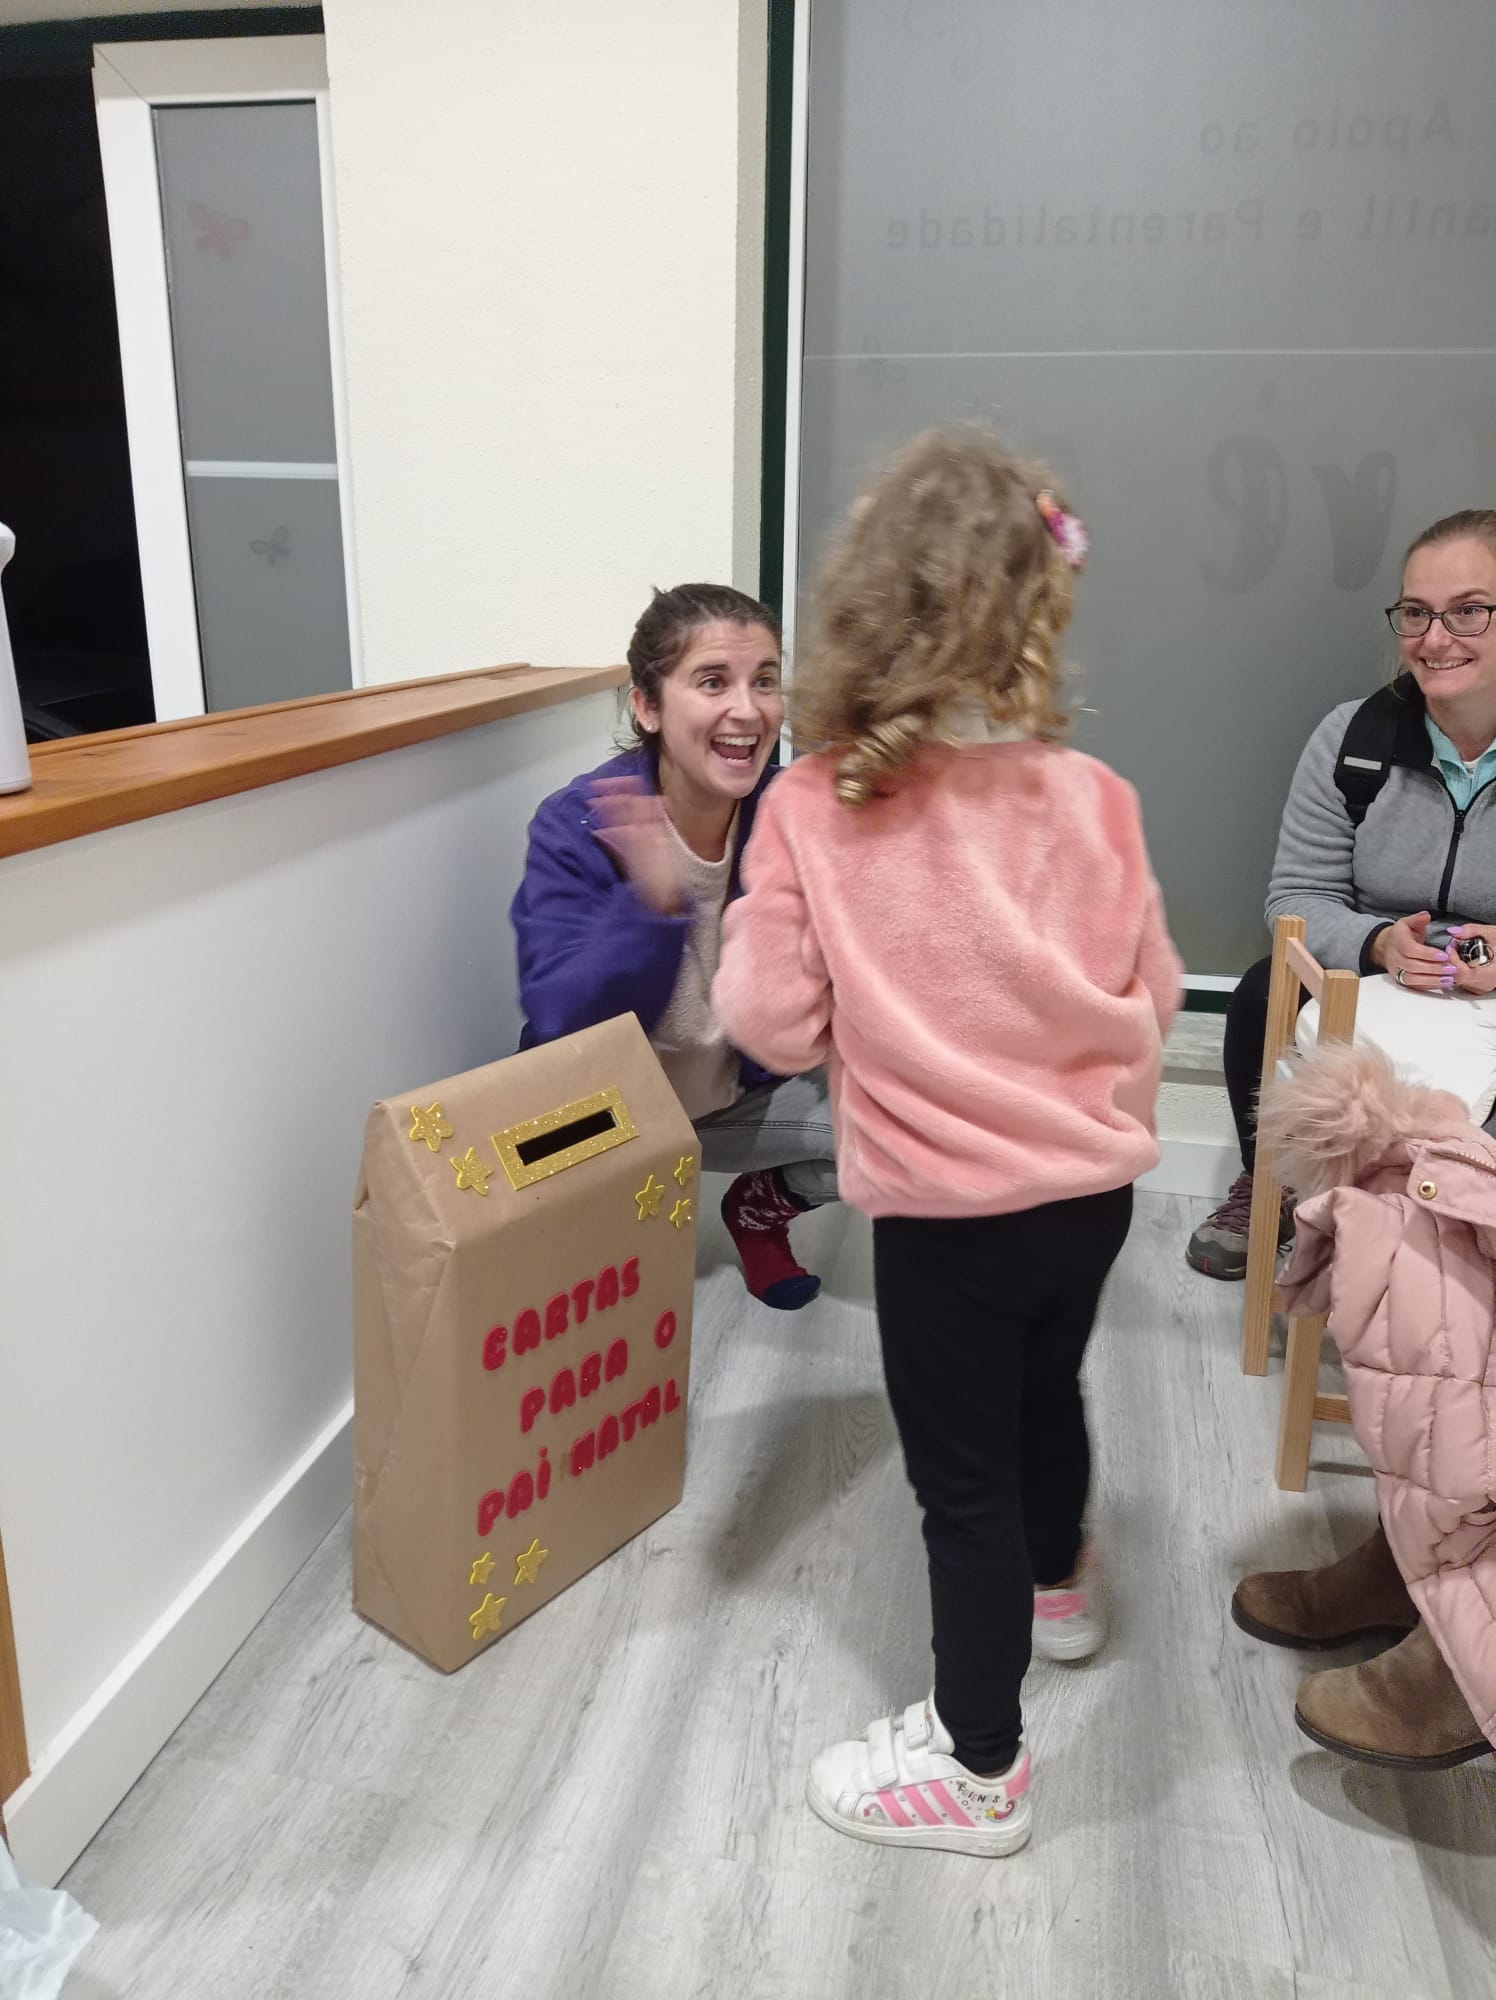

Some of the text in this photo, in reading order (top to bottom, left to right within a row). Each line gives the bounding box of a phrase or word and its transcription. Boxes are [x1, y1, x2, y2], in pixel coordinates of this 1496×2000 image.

[482, 1256, 640, 1371] CARTAS
[520, 1310, 677, 1433] PARA O
[571, 1378, 681, 1477] NATAL
